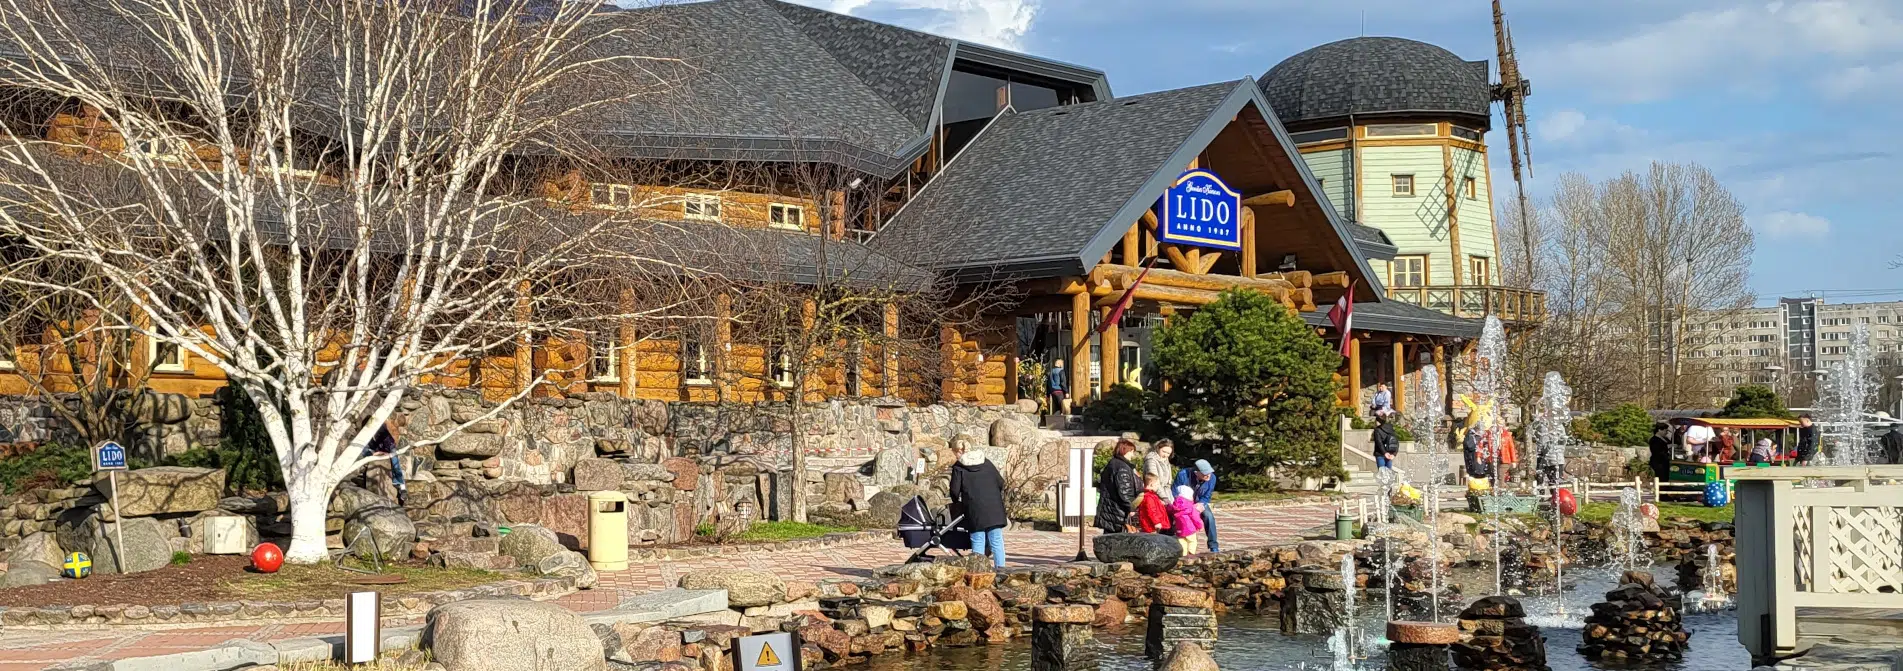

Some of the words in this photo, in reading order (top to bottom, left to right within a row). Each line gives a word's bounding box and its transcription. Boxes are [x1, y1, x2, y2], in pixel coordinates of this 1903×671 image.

[1176, 195, 1230, 224] LIDO
[1176, 223, 1202, 232] ANNO
[102, 451, 123, 461] LIDO
